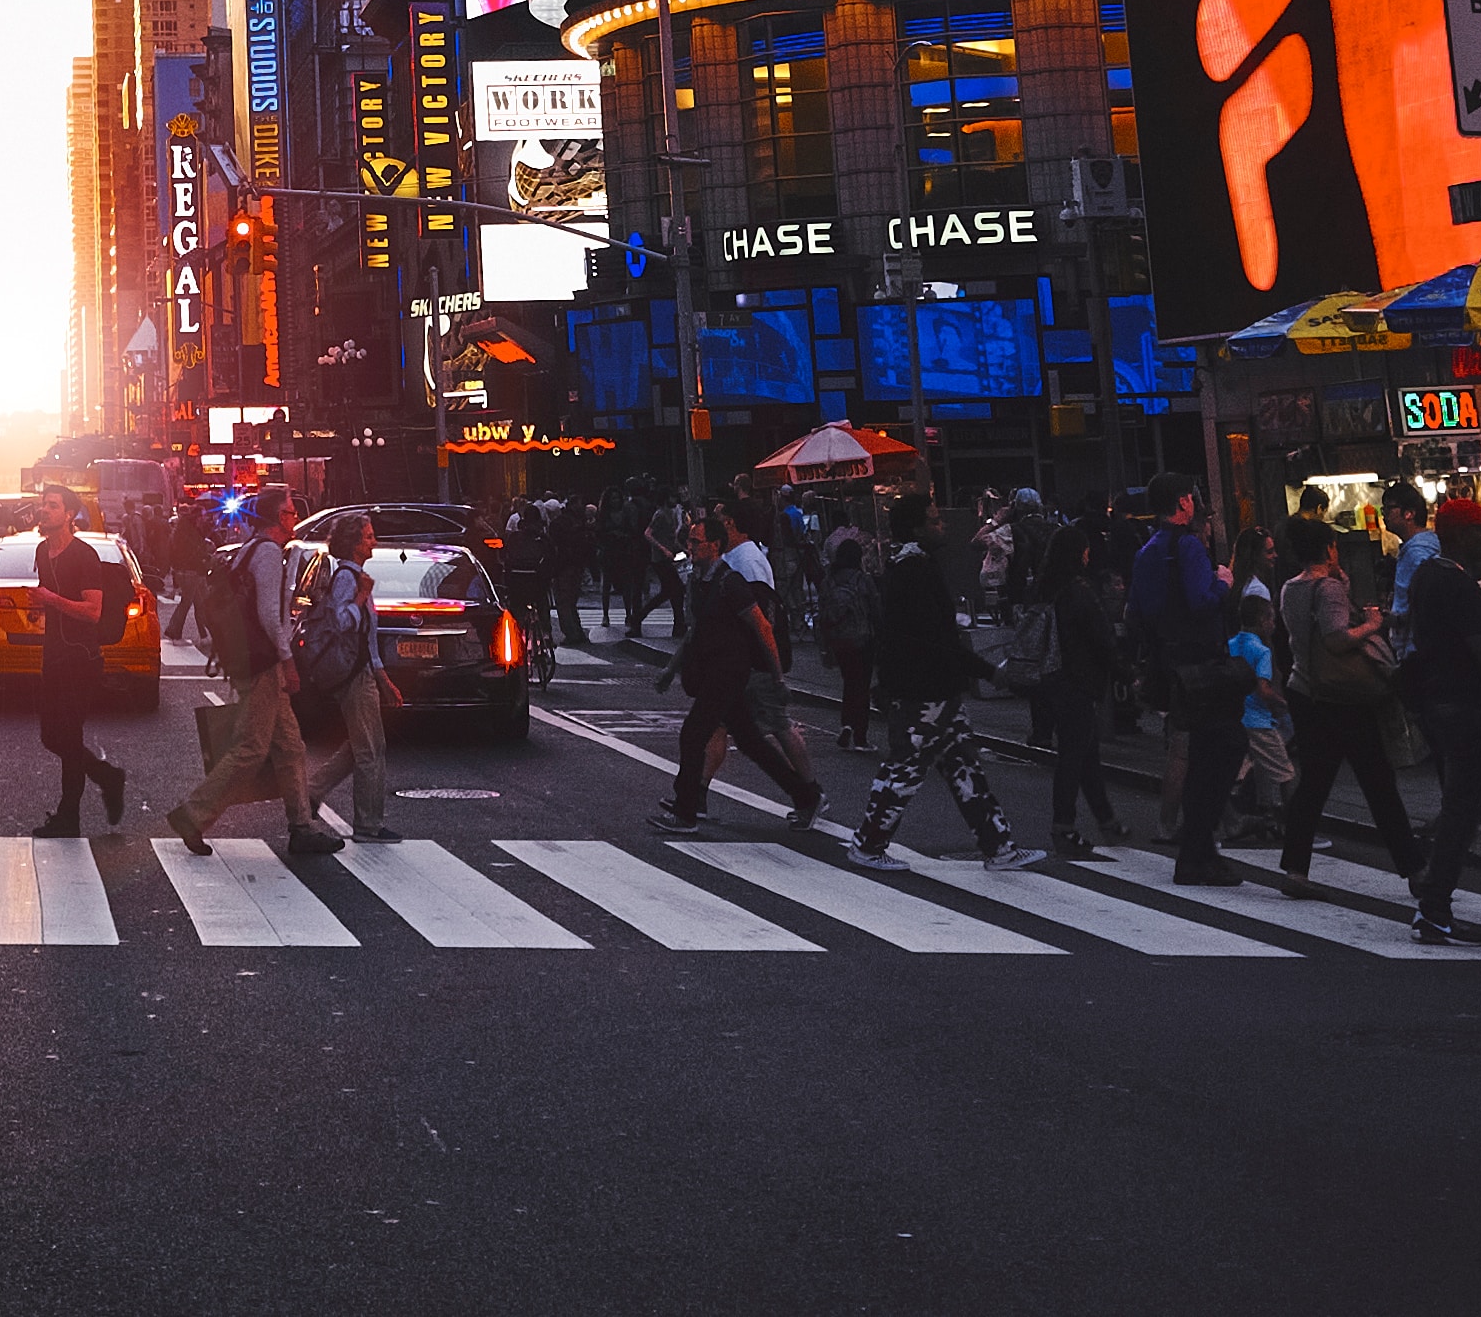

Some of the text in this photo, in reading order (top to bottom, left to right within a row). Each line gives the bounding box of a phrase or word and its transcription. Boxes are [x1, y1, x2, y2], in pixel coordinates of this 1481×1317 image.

[249, 17, 279, 113] STUDIOS
[418, 11, 451, 146] VICTORY
[489, 89, 599, 112] WORK
[494, 116, 599, 128] FOOTWEAR
[253, 123, 280, 180] DUKE
[171, 144, 201, 334] REGAL
[365, 213, 390, 269] NEW
[723, 222, 836, 263] CHASE
[888, 209, 1039, 250] CHASE
[1405, 391, 1479, 431] SODA
